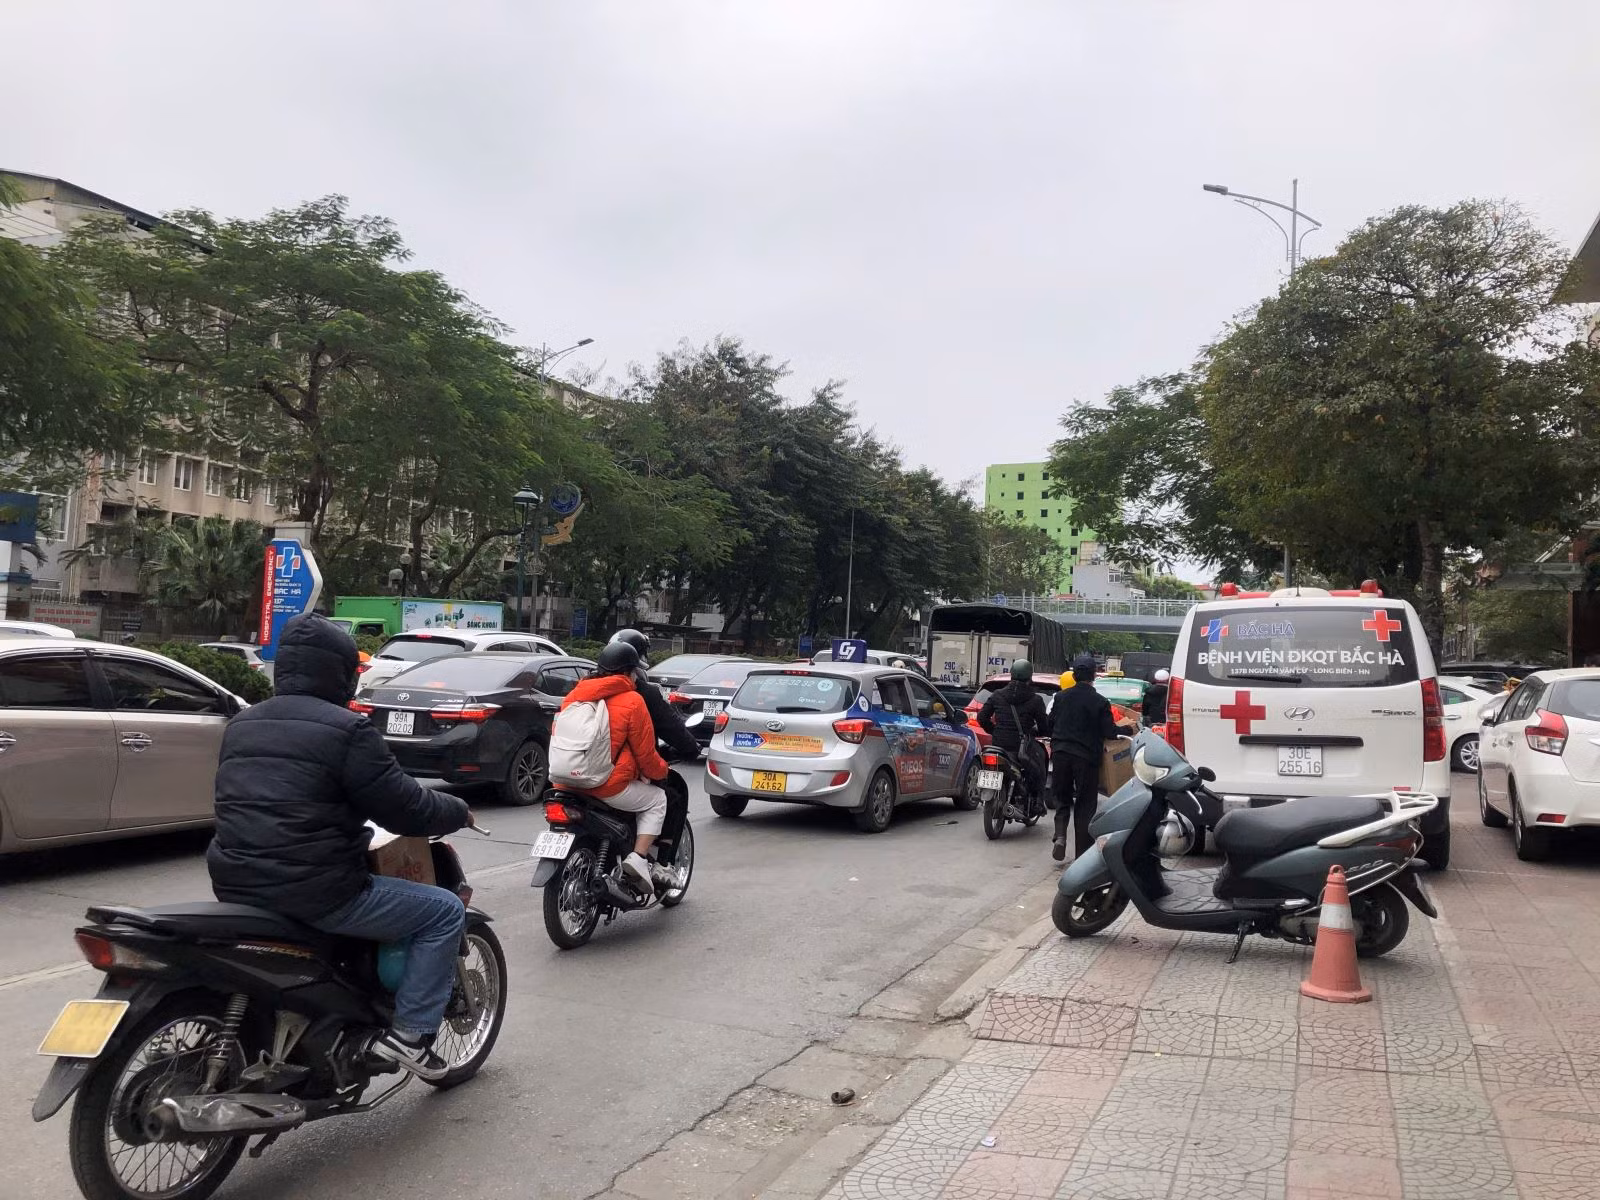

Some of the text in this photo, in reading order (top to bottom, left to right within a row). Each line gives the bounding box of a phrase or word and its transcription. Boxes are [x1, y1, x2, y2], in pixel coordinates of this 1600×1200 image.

[263, 550, 274, 641] HOSPITAL EMERGENCY
[1198, 646, 1405, 667] BỆNH VIỆN ĐKQT BẮC HÀ
[944, 661, 956, 670] 29C
[394, 712, 408, 722] 99A
[1288, 747, 1311, 760] 30E
[900, 760, 923, 774] ENEOS
[1279, 760, 1321, 774] 255.16
[762, 772, 777, 782] 30A
[756, 782, 782, 791] 241.62
